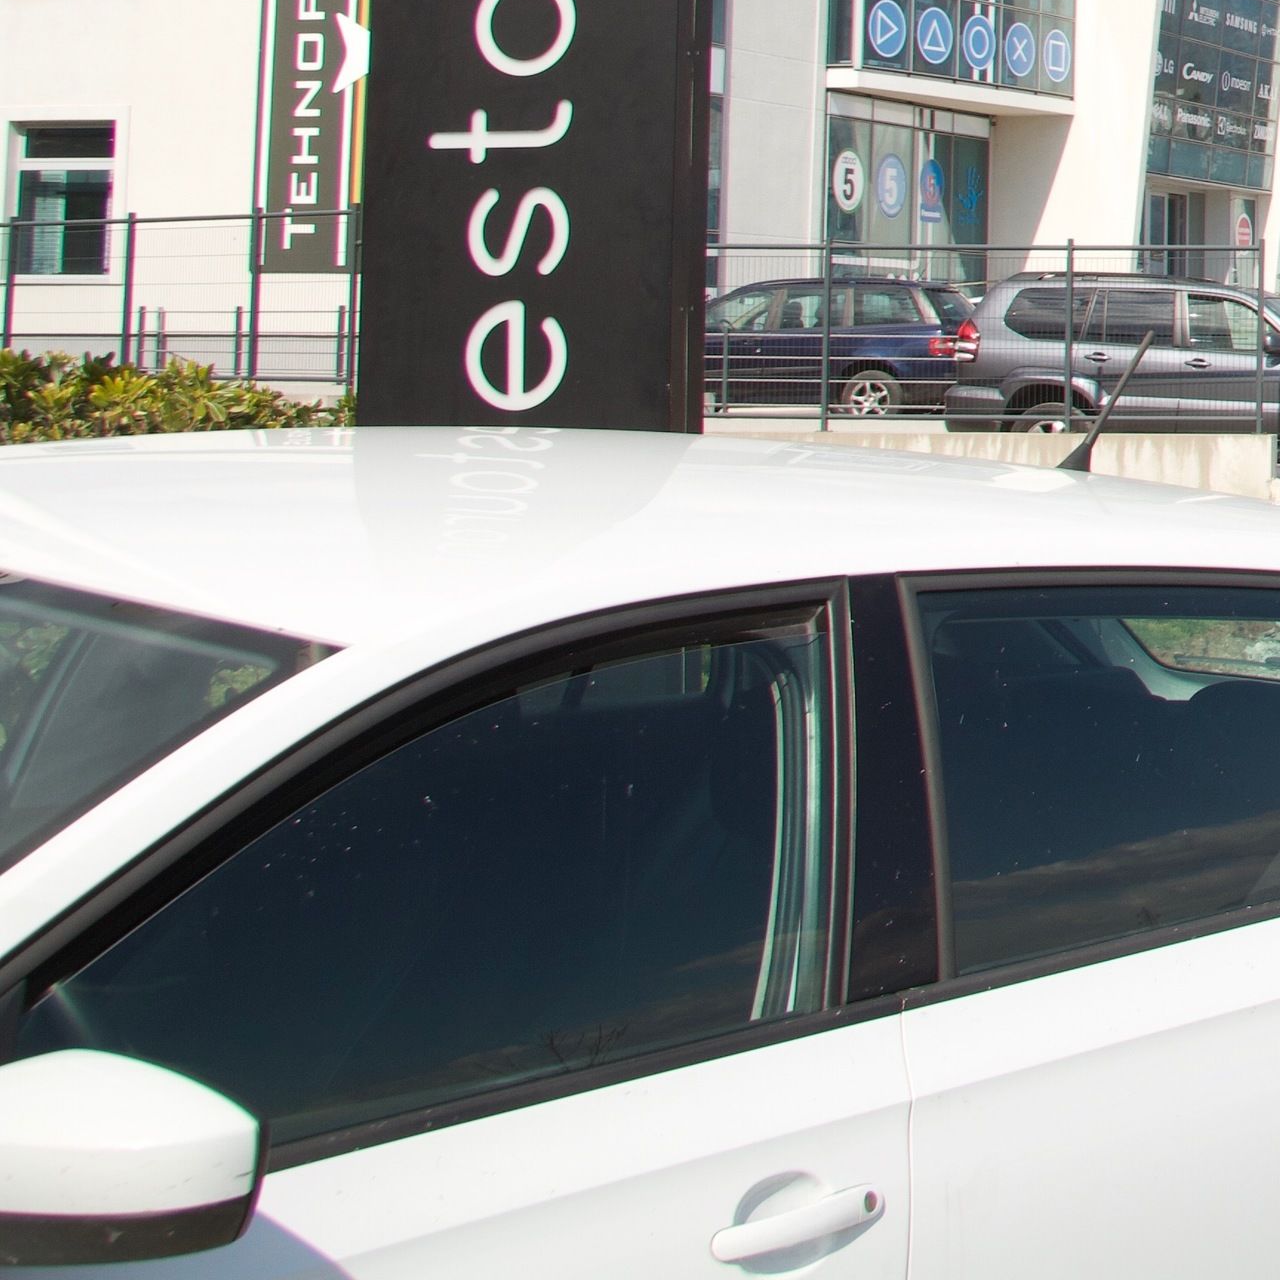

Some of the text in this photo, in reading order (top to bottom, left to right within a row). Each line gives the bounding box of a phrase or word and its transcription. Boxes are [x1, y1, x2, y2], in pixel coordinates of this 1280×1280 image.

[1226, 13, 1258, 34] SAMSUNG
[1163, 58, 1175, 74] LG
[843, 167, 855, 201] 5
[884, 167, 898, 206] 5
